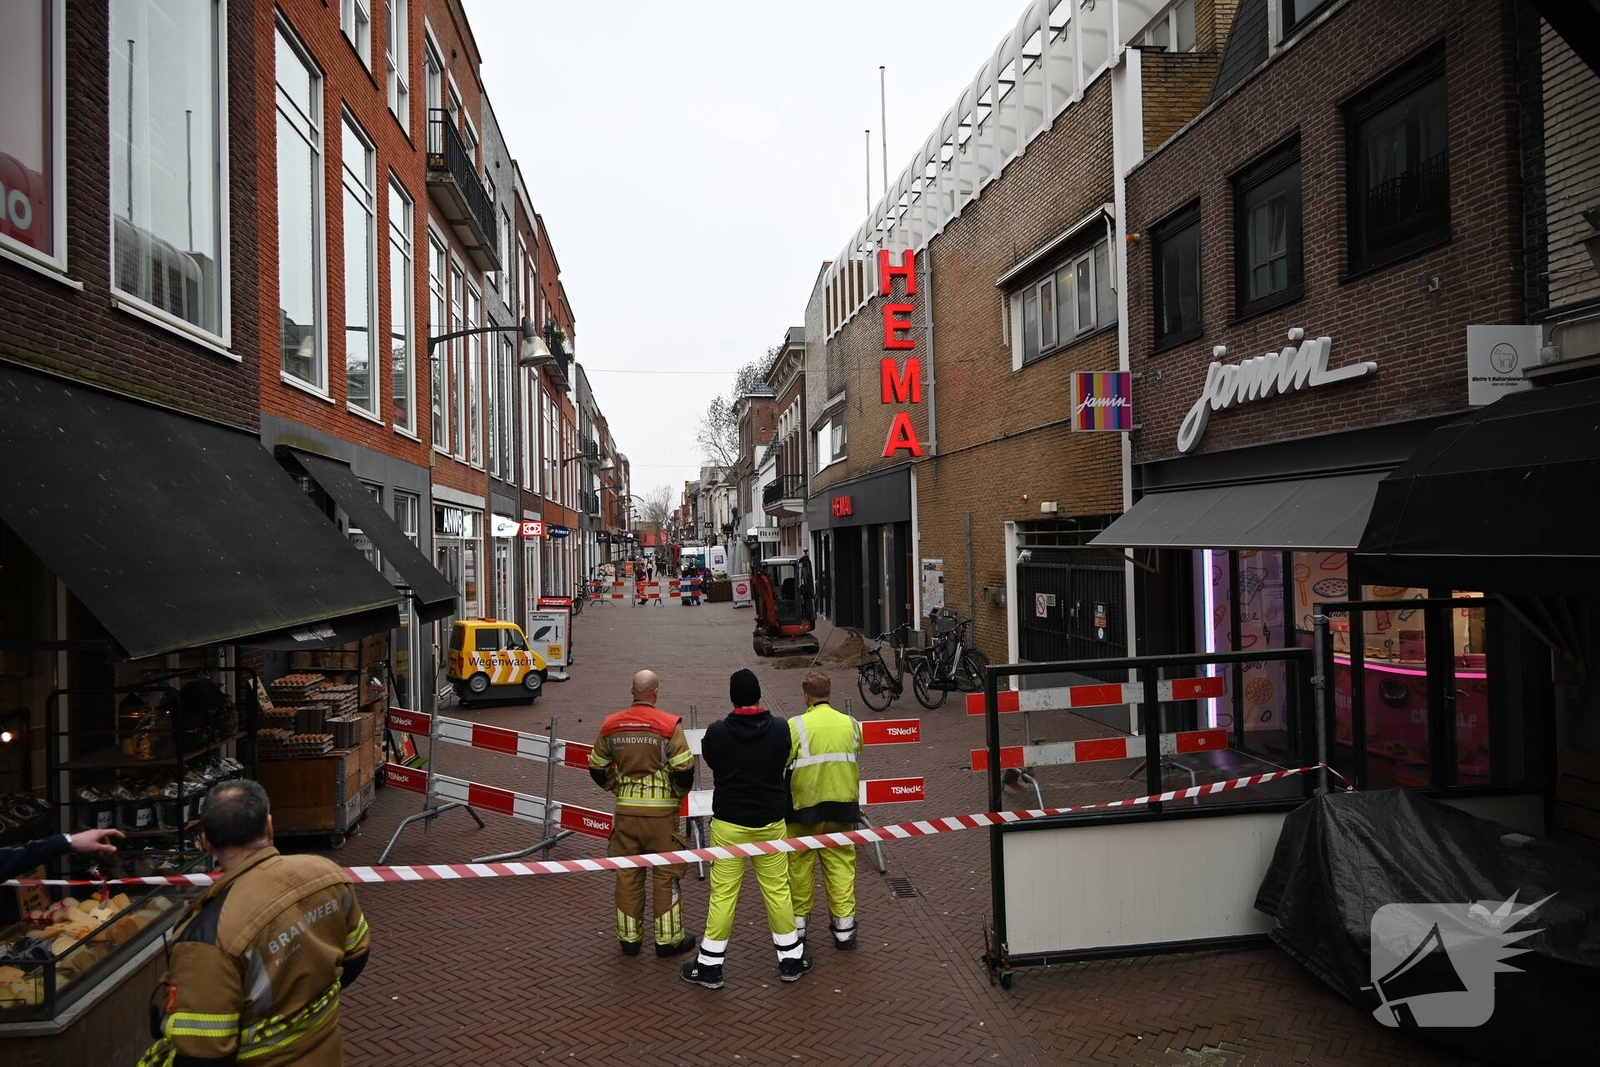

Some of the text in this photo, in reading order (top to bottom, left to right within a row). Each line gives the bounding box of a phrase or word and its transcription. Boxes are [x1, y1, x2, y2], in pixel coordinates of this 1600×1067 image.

[878, 249, 923, 457] HEMA
[1177, 327, 1378, 453] jamin
[1076, 393, 1131, 415] jamin
[832, 495, 852, 517] HEMA
[443, 508, 462, 535] ANWB
[468, 657, 536, 669] Wegenwacht
[390, 715, 409, 726] TSNed
[887, 727, 911, 736] TSNed
[612, 736, 658, 746] BRANDWEER
[387, 772, 406, 783] TSNed
[891, 785, 915, 795] TSNed
[582, 817, 604, 830] TSNed
